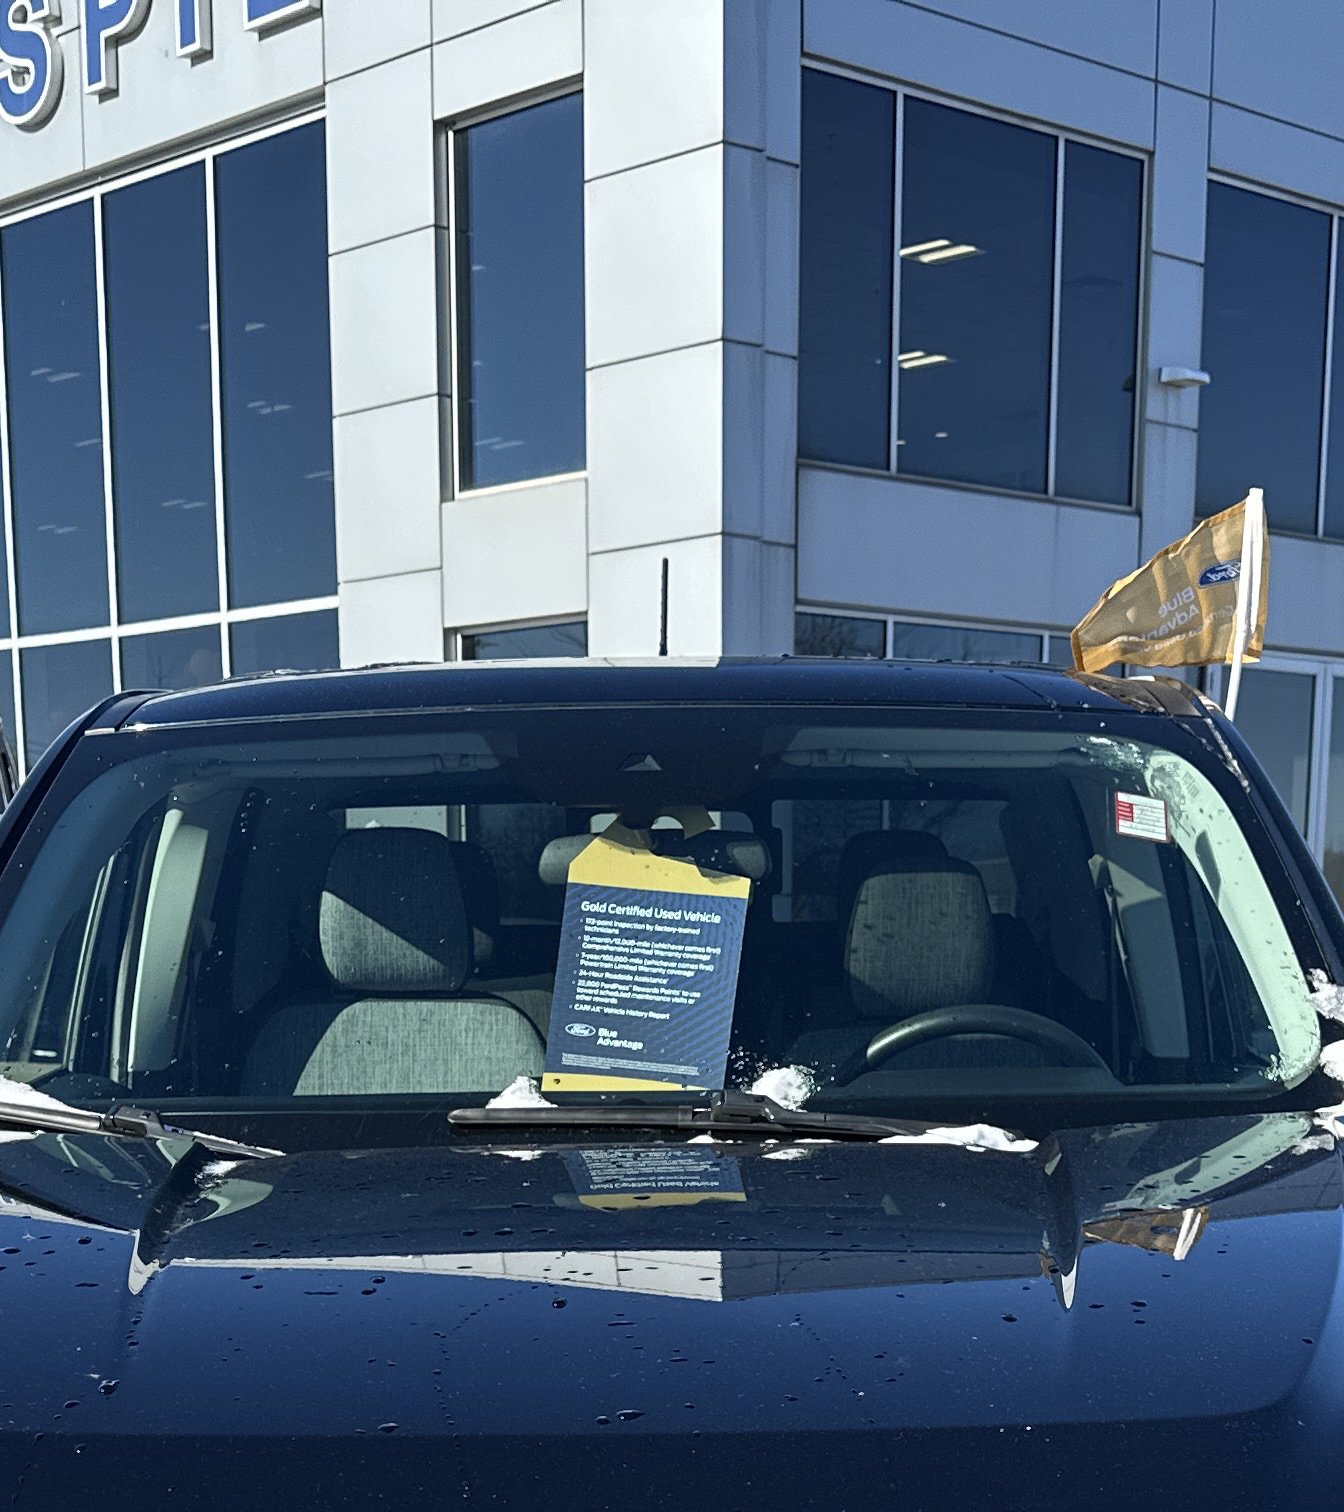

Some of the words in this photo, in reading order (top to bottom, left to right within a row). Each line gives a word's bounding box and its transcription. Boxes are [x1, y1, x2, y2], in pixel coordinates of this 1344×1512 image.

[581, 901, 607, 913] Gold
[608, 904, 653, 917] Certified
[654, 908, 682, 920] Used
[684, 910, 721, 923] Vehicle
[598, 1028, 618, 1038] Blue
[597, 1037, 643, 1050] Advantage
